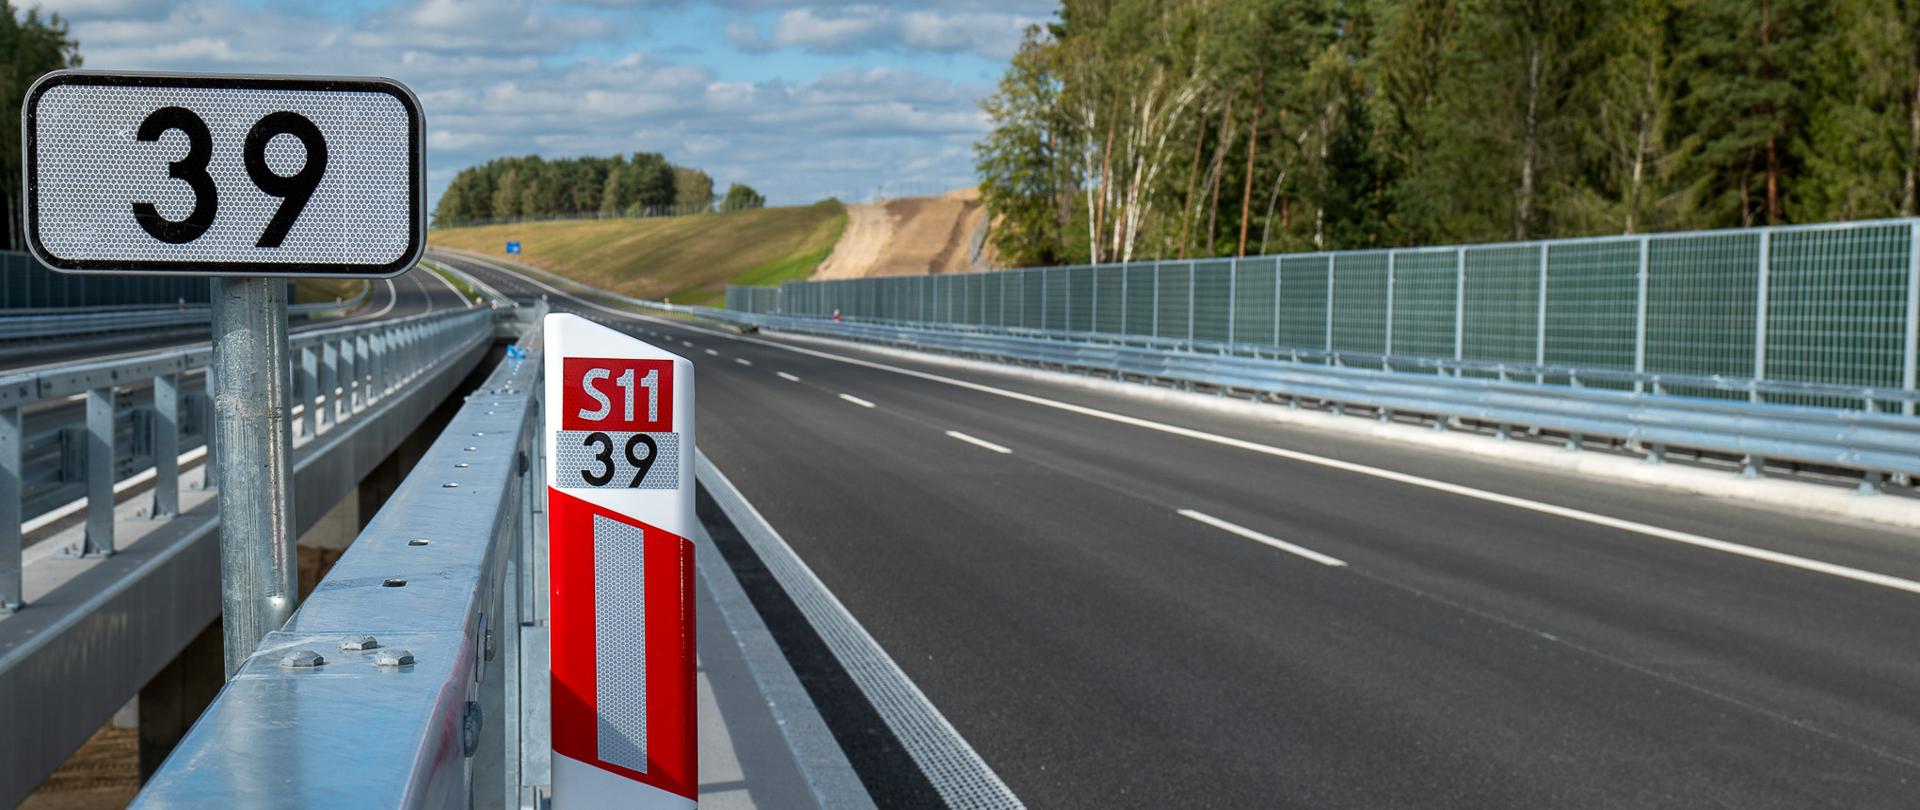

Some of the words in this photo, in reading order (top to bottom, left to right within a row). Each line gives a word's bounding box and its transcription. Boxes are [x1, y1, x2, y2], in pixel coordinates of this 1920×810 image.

[132, 106, 328, 247] 39
[578, 368, 659, 422] S11
[581, 432, 658, 488] 39
